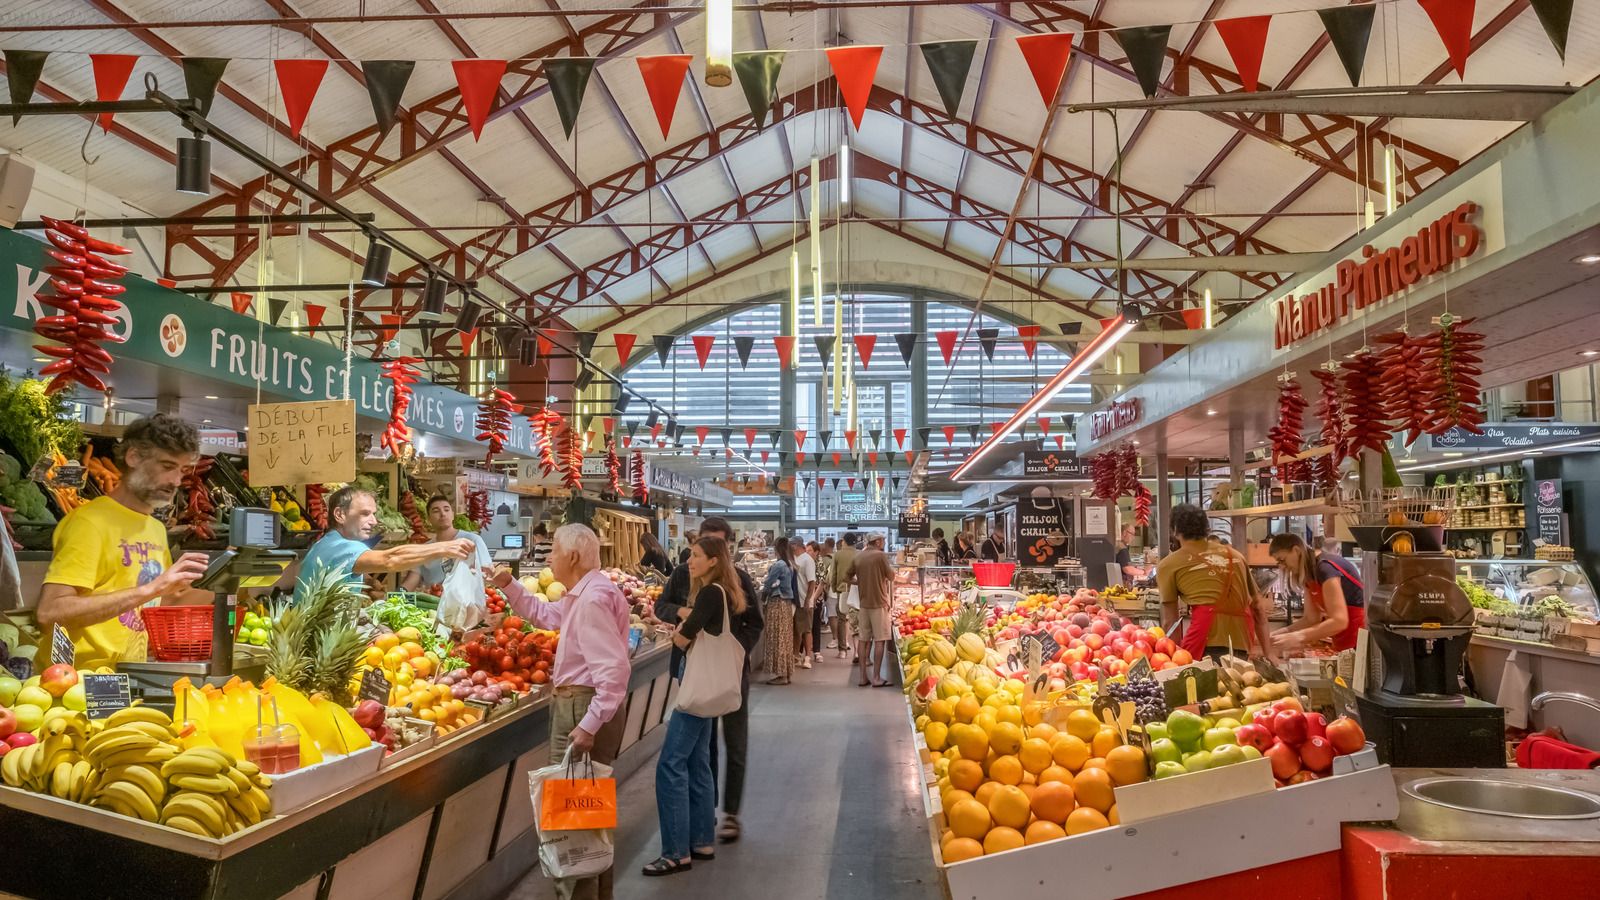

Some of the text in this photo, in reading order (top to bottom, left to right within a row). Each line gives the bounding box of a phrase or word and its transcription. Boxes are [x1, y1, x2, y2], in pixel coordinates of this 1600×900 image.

[1275, 200, 1480, 349] Manu Primeurs
[13, 263, 133, 343] KO
[210, 328, 314, 394] FRUITS
[325, 365, 351, 400] ET
[255, 405, 329, 429] DÉBUT
[257, 422, 352, 446] DE LA FILE
[473, 412, 523, 449] PEUR
[1529, 426, 1550, 436] Plats
[1022, 515, 1058, 524] MAISON
[1020, 528, 1061, 536] CHAIL
[1418, 592, 1446, 600] SEMPA
